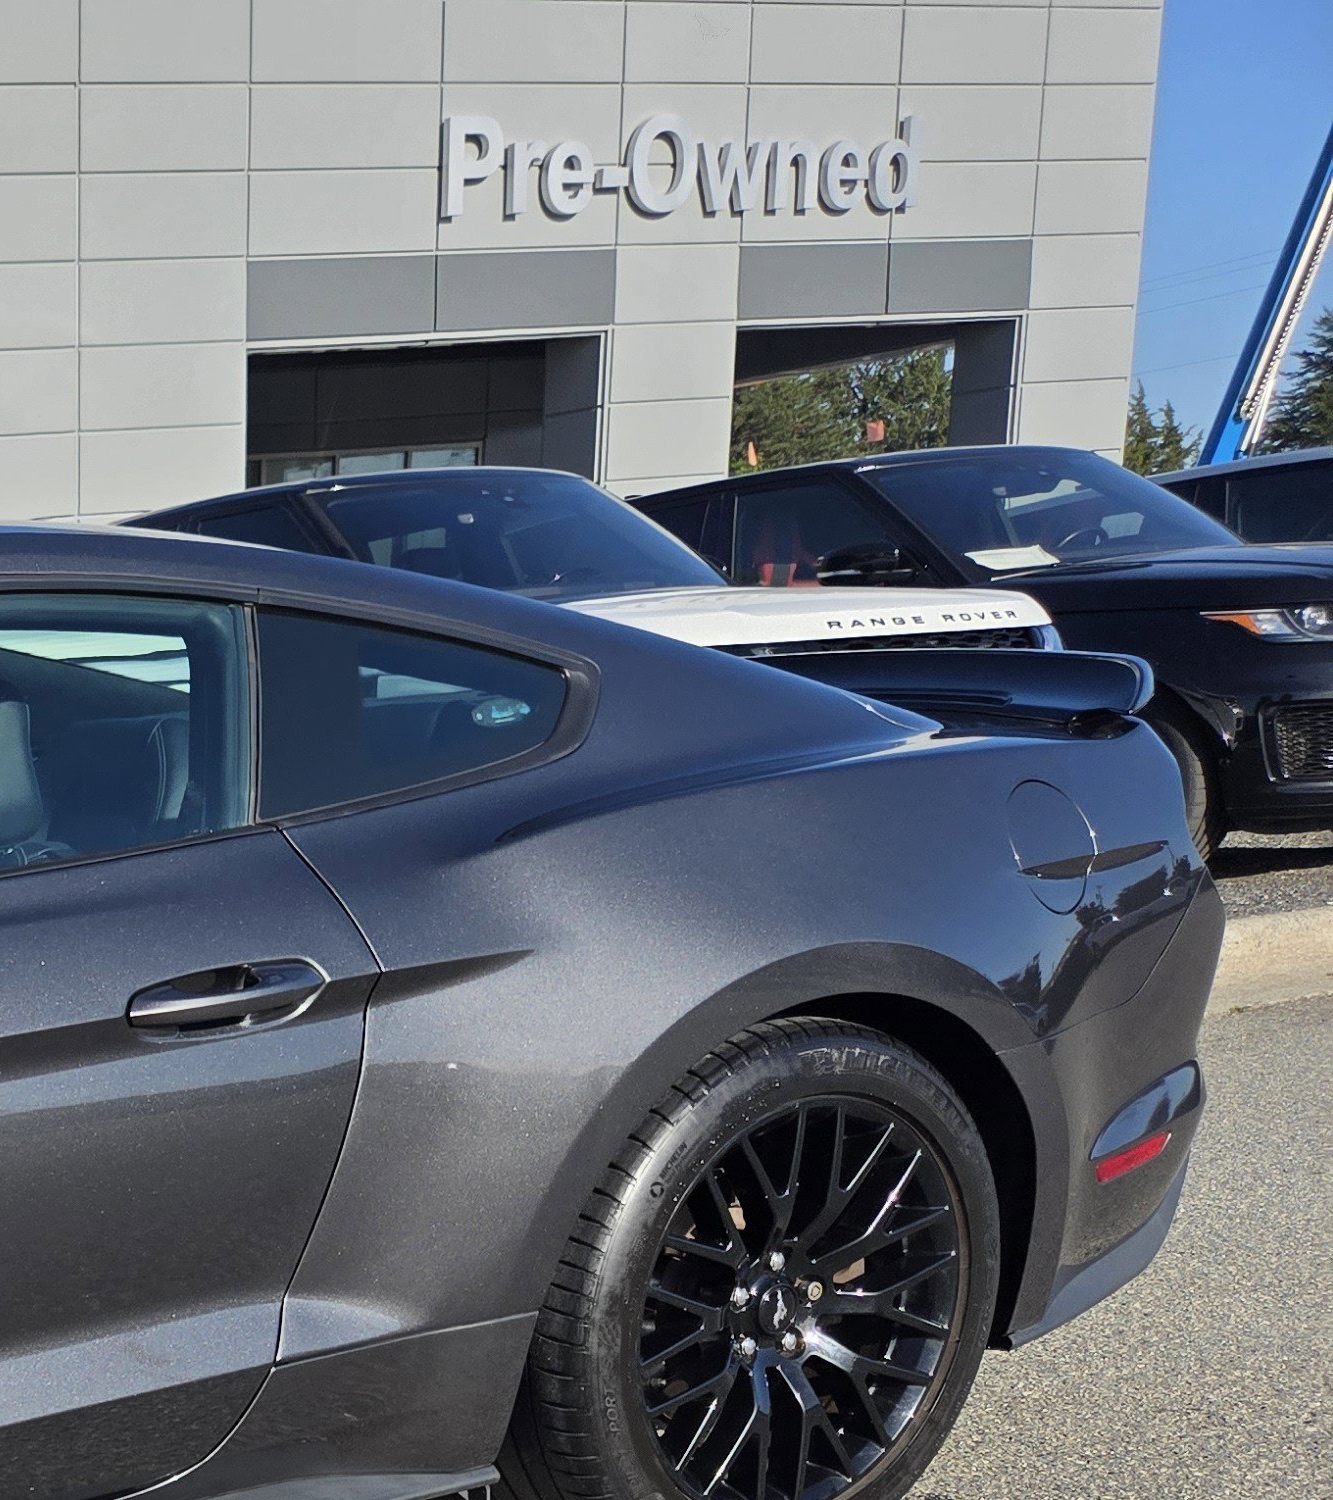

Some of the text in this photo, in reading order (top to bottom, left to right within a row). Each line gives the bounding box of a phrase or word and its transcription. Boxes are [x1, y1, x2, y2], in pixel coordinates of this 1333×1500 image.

[439, 112, 923, 219] Pre-Owned
[826, 610, 1018, 629] RANGE ROVER
